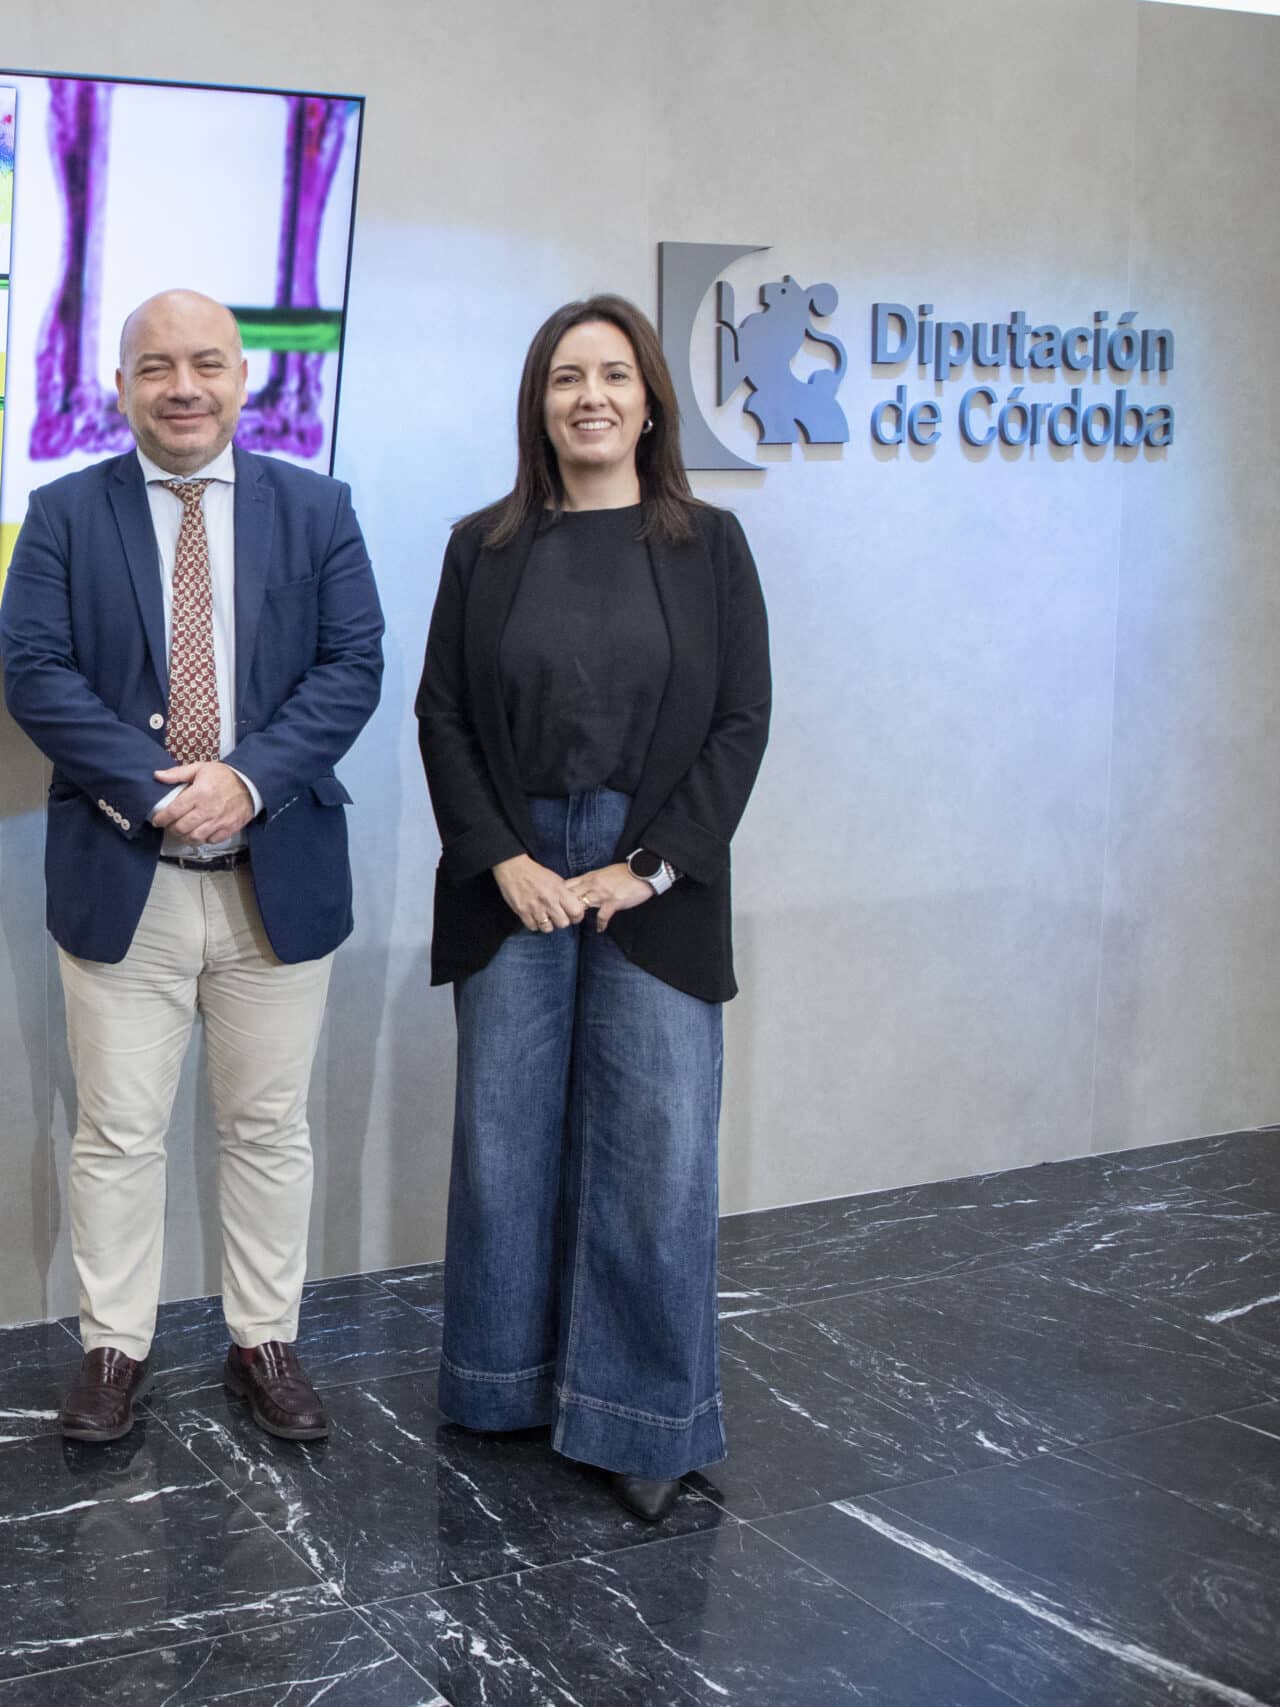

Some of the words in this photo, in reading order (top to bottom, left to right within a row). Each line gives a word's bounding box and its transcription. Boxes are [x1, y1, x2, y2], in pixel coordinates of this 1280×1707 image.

[871, 302, 1176, 382] Diputación
[871, 384, 943, 448] de
[959, 384, 1176, 448] Córdoba
